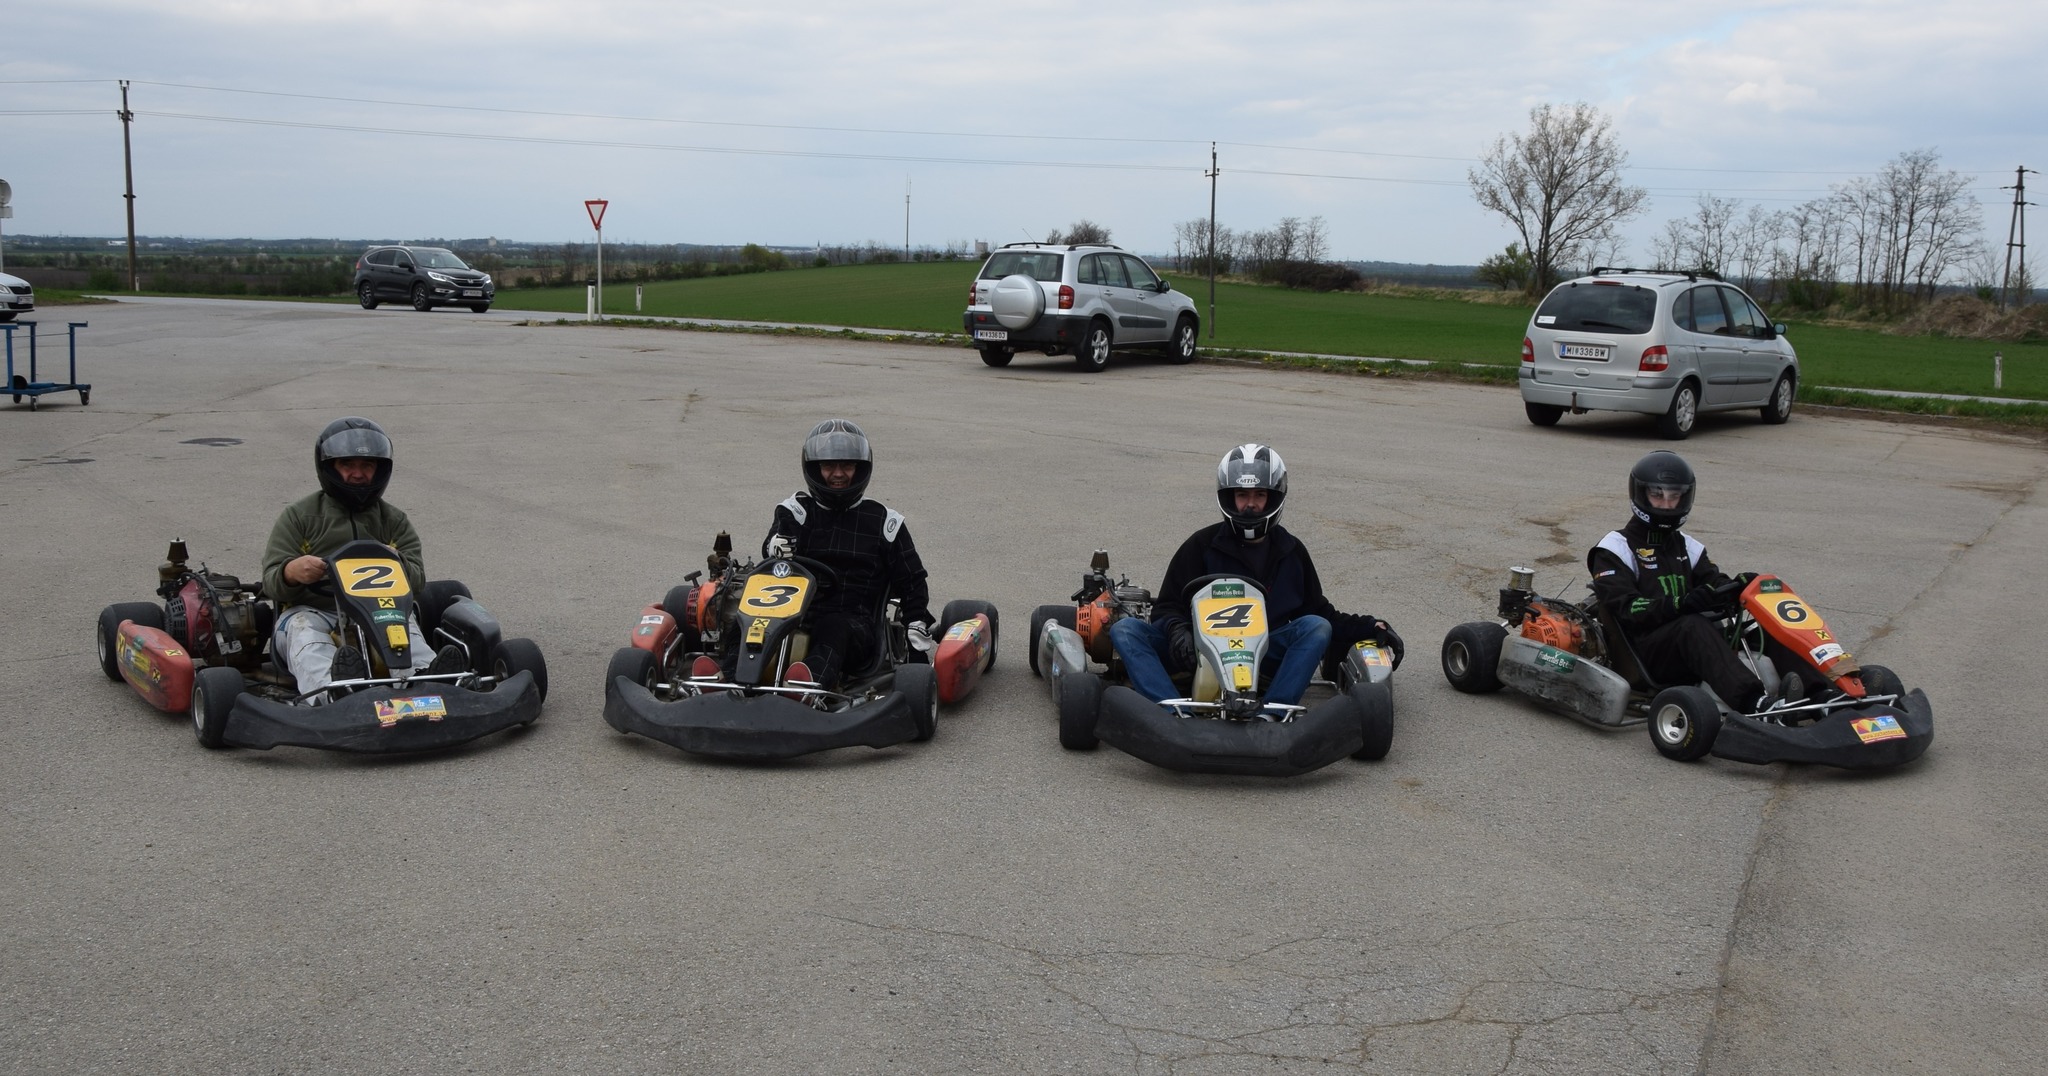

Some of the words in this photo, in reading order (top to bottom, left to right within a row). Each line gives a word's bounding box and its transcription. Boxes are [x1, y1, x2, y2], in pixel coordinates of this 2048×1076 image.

[1566, 346, 1575, 355] MI
[1580, 347, 1594, 357] 336
[1594, 348, 1606, 357] BW
[350, 565, 397, 591] 2
[747, 585, 800, 608] 3
[1205, 603, 1256, 630] 4
[1776, 599, 1808, 624] 6
